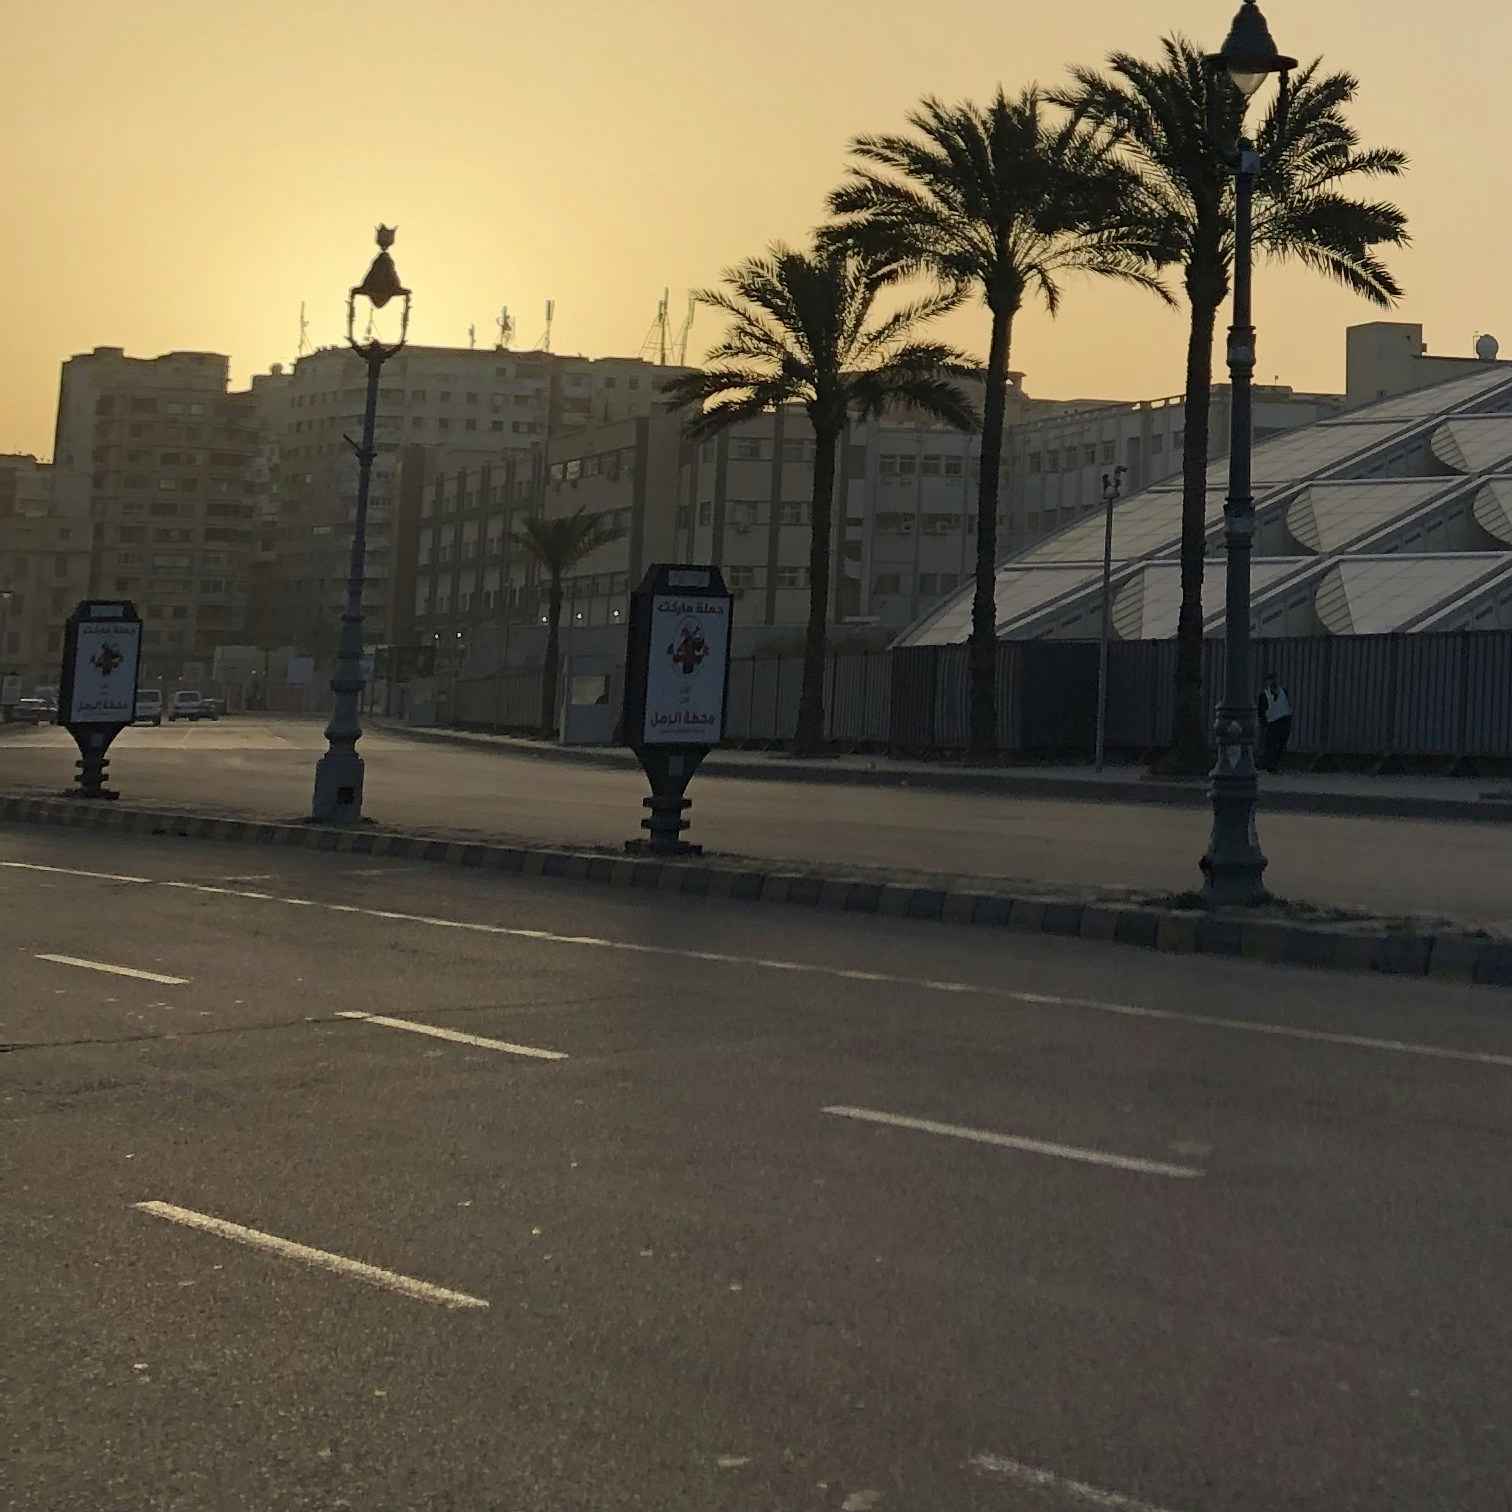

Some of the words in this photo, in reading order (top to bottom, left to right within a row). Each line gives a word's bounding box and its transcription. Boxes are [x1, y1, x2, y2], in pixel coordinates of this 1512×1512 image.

[658, 601, 693, 616] ماركت
[697, 601, 724, 616] جملة
[650, 712, 682, 727] الرمل
[683, 710, 716, 724] محطة
